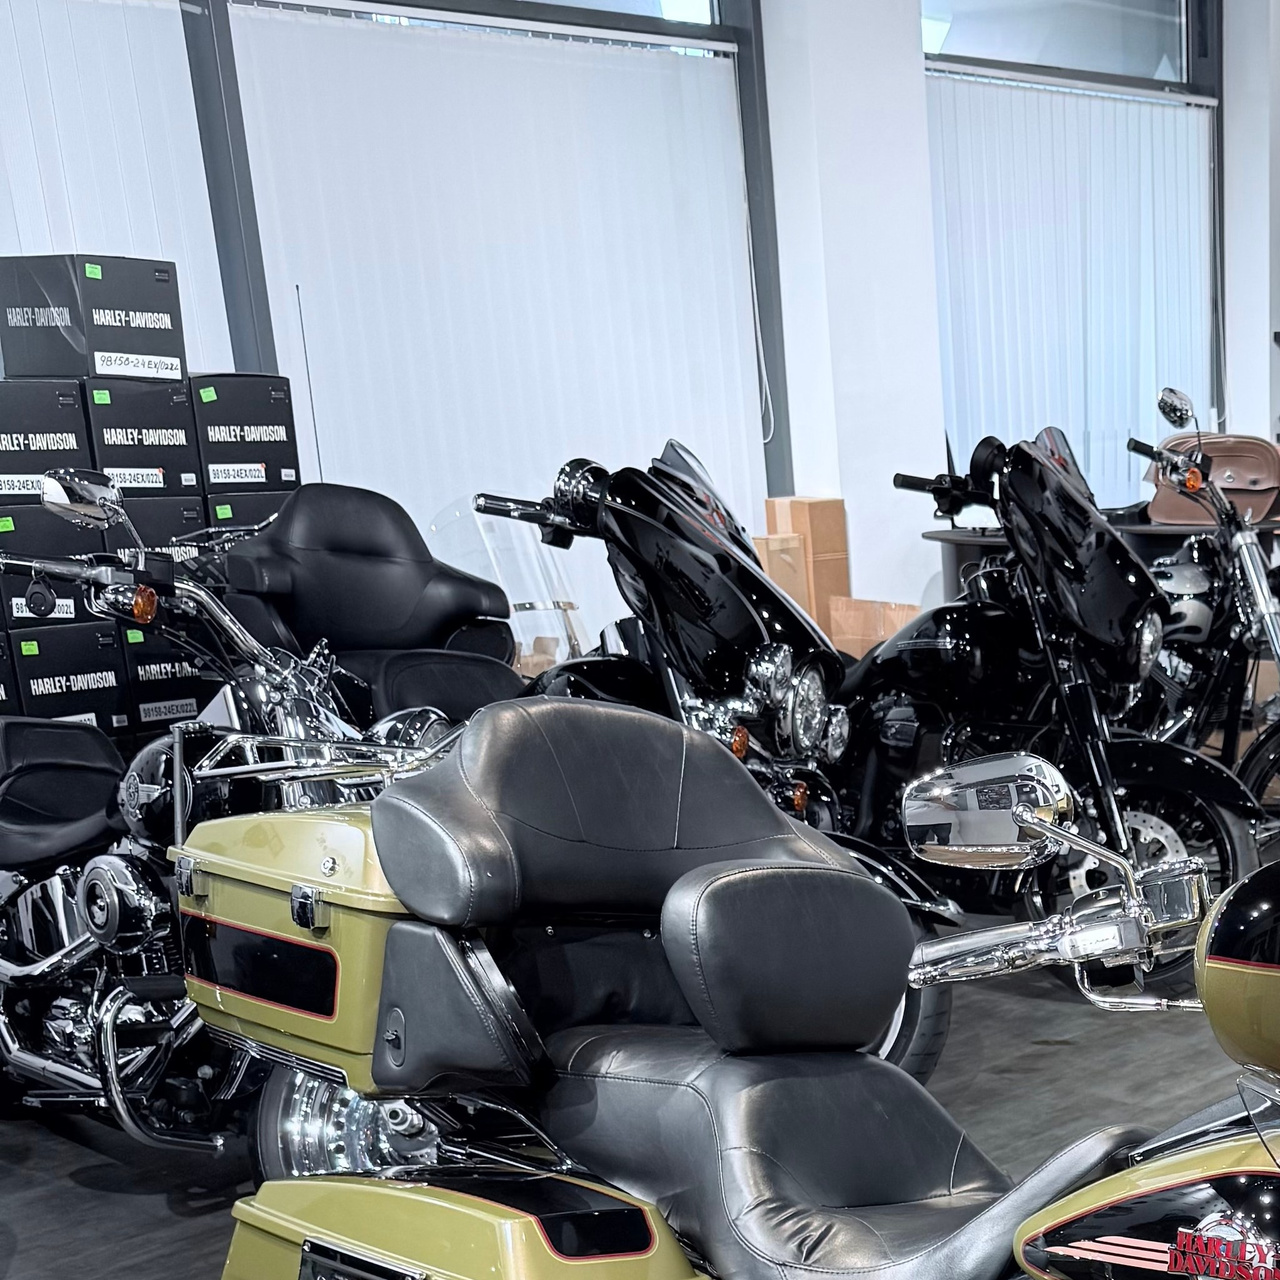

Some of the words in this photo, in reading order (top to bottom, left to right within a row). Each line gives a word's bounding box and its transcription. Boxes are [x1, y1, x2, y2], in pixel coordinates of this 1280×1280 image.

[6, 307, 71, 327] HARLEY-DAVIDSON
[92, 308, 173, 330] HARLEY-DAVIDSON
[103, 428, 188, 446] HARLEY-DAVIDSON
[207, 425, 288, 442] HARLEY-DAVIDSON
[30, 671, 118, 696] HARLEY-DAVIDSON
